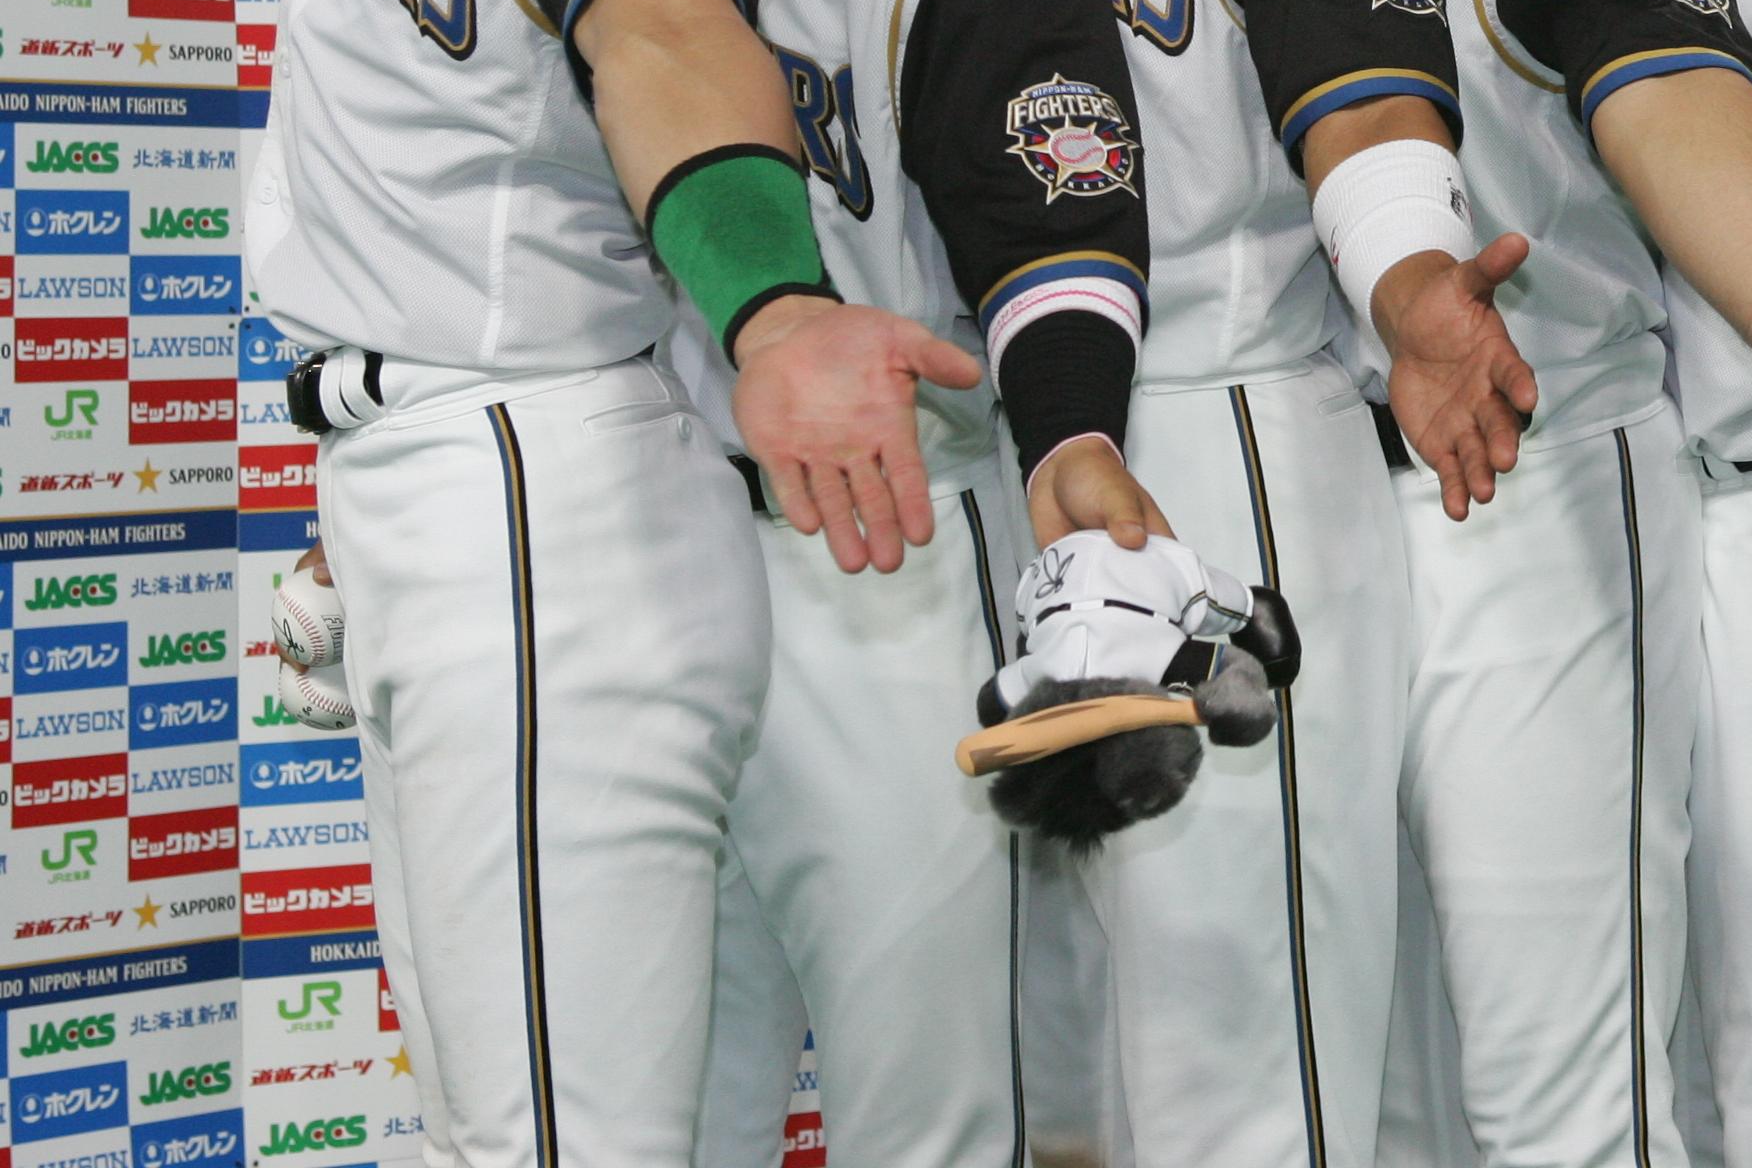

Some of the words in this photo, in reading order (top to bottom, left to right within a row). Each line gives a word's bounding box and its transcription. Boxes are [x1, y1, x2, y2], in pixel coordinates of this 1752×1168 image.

[20, 37, 124, 59] 道新スポーツ
[169, 45, 233, 62] SAPPORO
[36, 94, 121, 114] NIPPON-HAM
[127, 97, 187, 115] FIGHTERS
[1014, 94, 1121, 129] FIGHTERS
[26, 141, 119, 173] JACCS
[132, 149, 236, 170] 北海道新聞
[48, 210, 121, 236] ホクレン
[141, 207, 229, 239] JACCS
[18, 277, 126, 299] LAWSON
[161, 275, 232, 300] ホクレン
[16, 337, 127, 361] ビックカメラ
[132, 336, 235, 358] LAWSON
[44, 389, 99, 427] JR
[131, 399, 235, 424] ビックカメラ
[19, 472, 124, 493] 道新スポーツ
[169, 467, 233, 485] SAPPORO
[35, 527, 119, 549] NIPPON-HAM
[125, 523, 185, 543] FIGHTERS
[25, 573, 117, 611] JACCS
[131, 571, 233, 598] 北海道新聞
[47, 642, 120, 672] ホクレン
[140, 630, 226, 668] JACCS
[16, 709, 125, 739] LAWSON
[160, 698, 229, 727] ホクレン
[14, 774, 126, 807] ビックカメラ
[132, 762, 235, 794] LAWSON
[41, 829, 98, 871] JR
[130, 827, 237, 861] ビックカメラ
[244, 821, 370, 851] LAWSON
[170, 895, 236, 919] SAPPORO
[14, 909, 122, 940] 道新スポーツ
[29, 969, 118, 995] NIPPON-HAM
[123, 956, 188, 981] FIGHTERS
[278, 981, 343, 1021] JR
[130, 1001, 238, 1036] 北海道新聞
[20, 1013, 115, 1058] JACCS
[140, 1061, 232, 1106] JACCS
[250, 1059, 373, 1087] 道新スポーツ
[44, 1085, 119, 1119] ホクレン
[165, 1131, 237, 1164] ホクレン
[259, 1115, 367, 1156] JACCS
